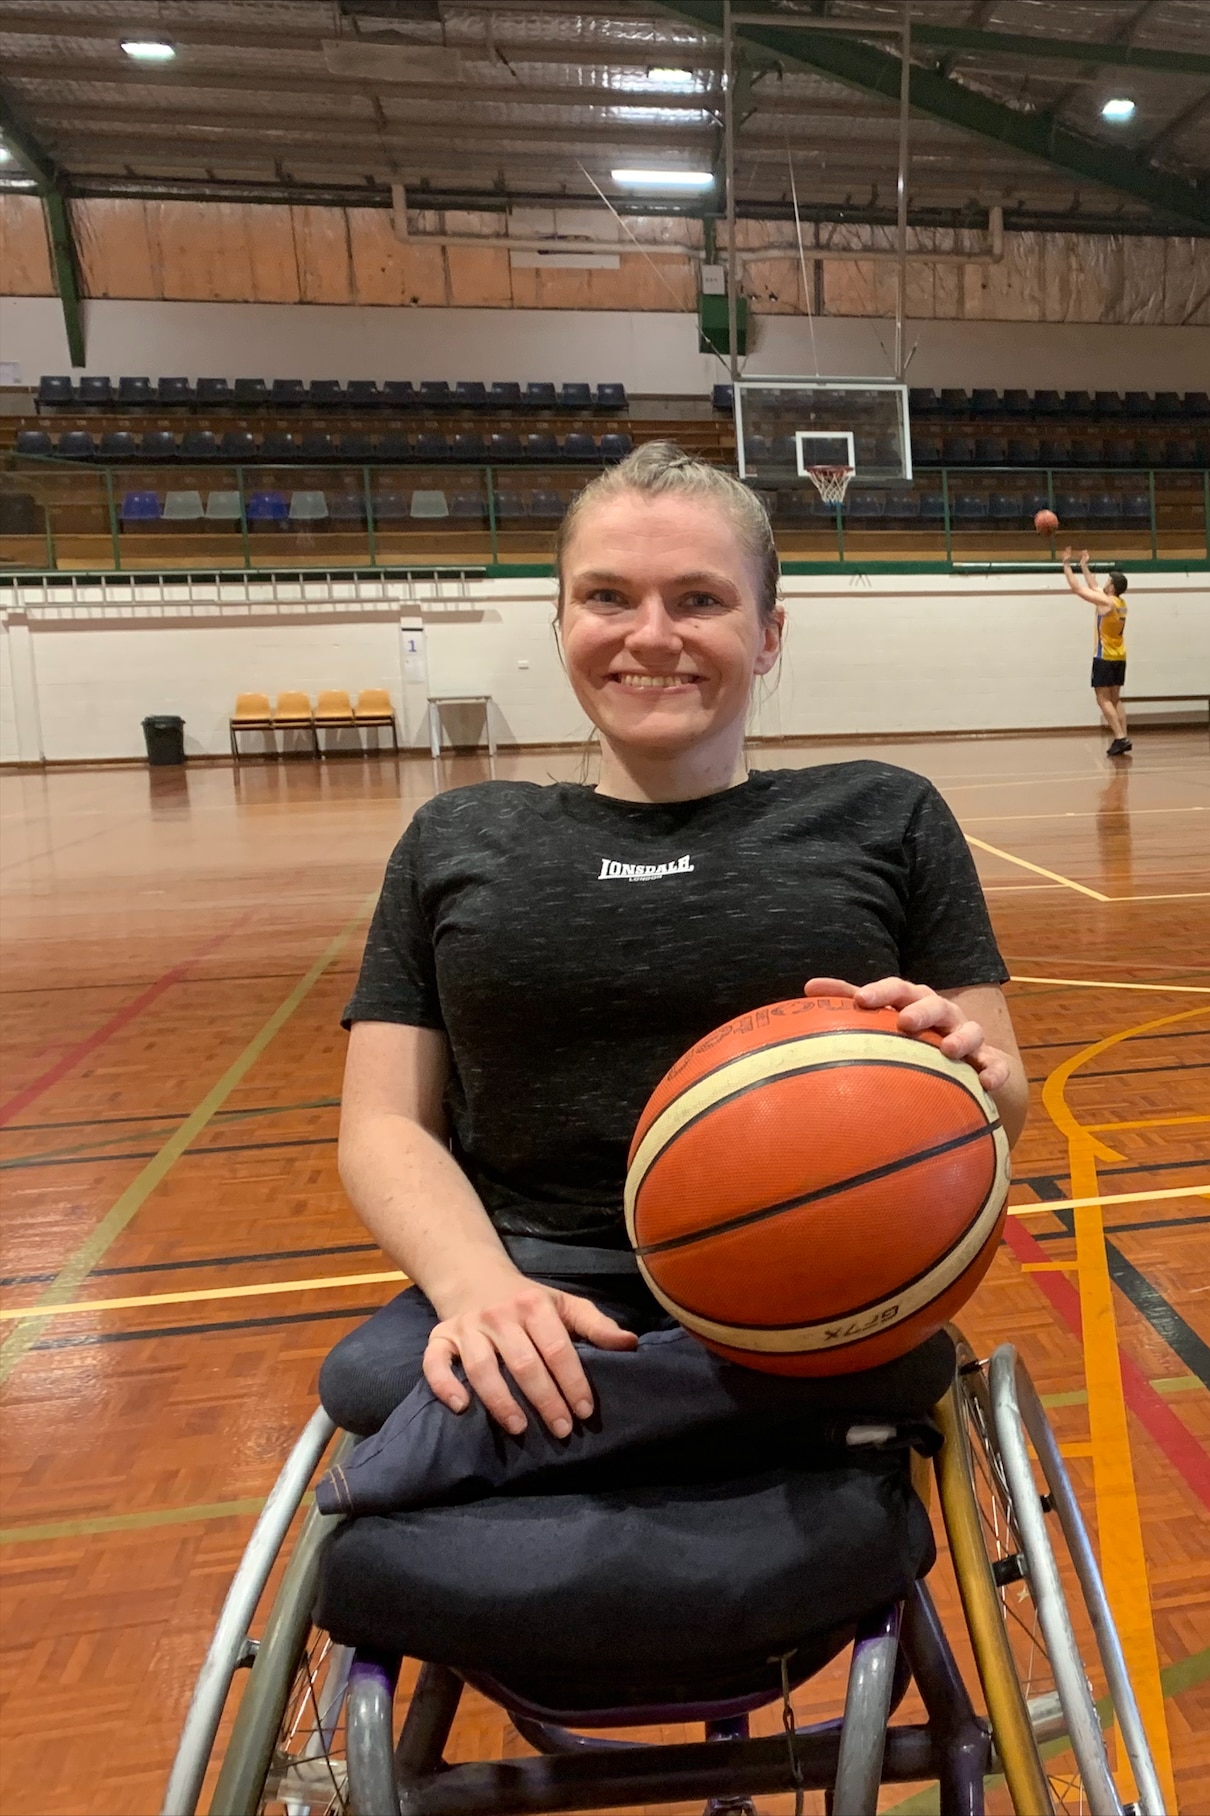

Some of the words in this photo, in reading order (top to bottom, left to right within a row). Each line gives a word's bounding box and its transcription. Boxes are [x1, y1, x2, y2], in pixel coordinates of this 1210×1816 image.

[408, 639, 417, 653] 1
[598, 855, 694, 880] LONSDALE
[824, 1305, 899, 1341] GF7X
